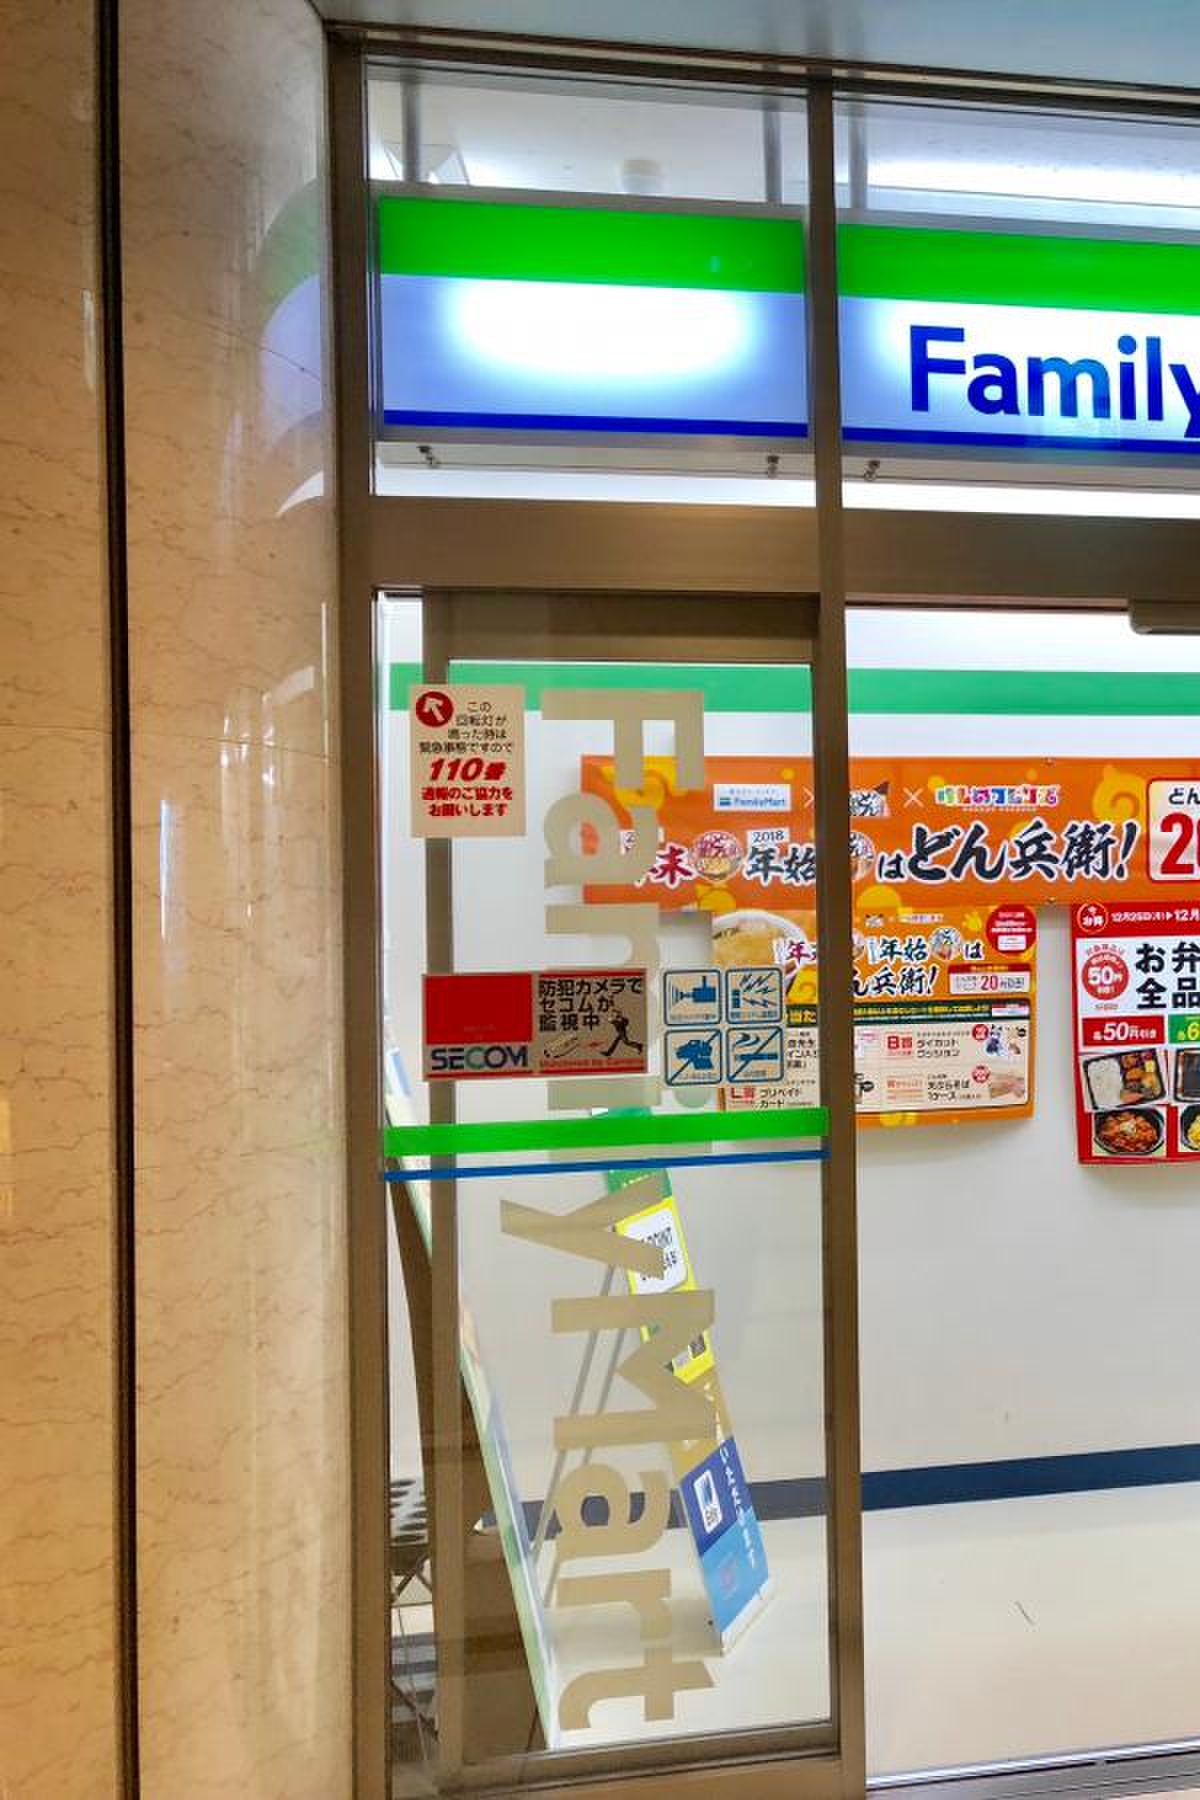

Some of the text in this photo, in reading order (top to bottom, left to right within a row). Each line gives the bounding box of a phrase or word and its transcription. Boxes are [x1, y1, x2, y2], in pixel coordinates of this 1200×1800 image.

[752, 830, 785, 843] 2018
[539, 979, 642, 996] 防犯カメラで
[540, 995, 615, 1013] セコムが
[540, 1012, 600, 1032] 監視中
[431, 1046, 528, 1071] SECOM
